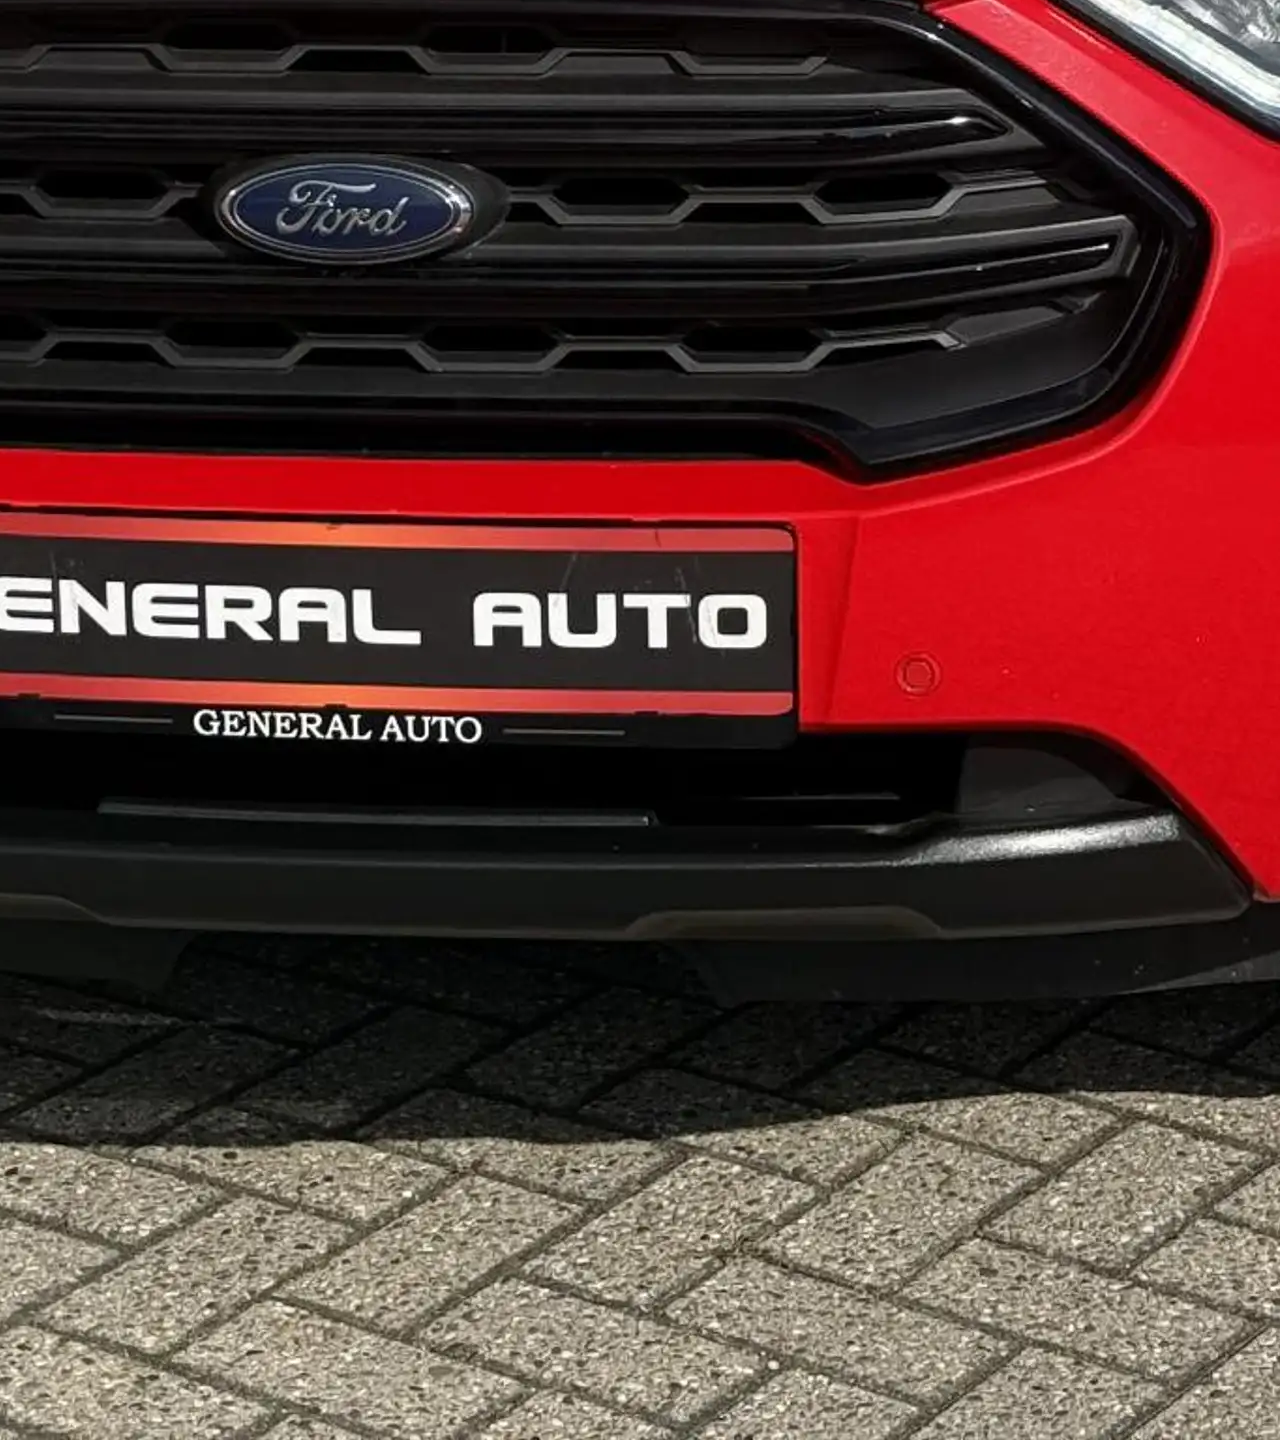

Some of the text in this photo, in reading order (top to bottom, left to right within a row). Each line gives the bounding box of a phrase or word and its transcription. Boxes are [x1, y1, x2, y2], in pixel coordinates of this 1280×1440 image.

[275, 179, 410, 236] Ford
[472, 591, 768, 650] AUTO
[193, 708, 483, 744] GENERAL AUTO
